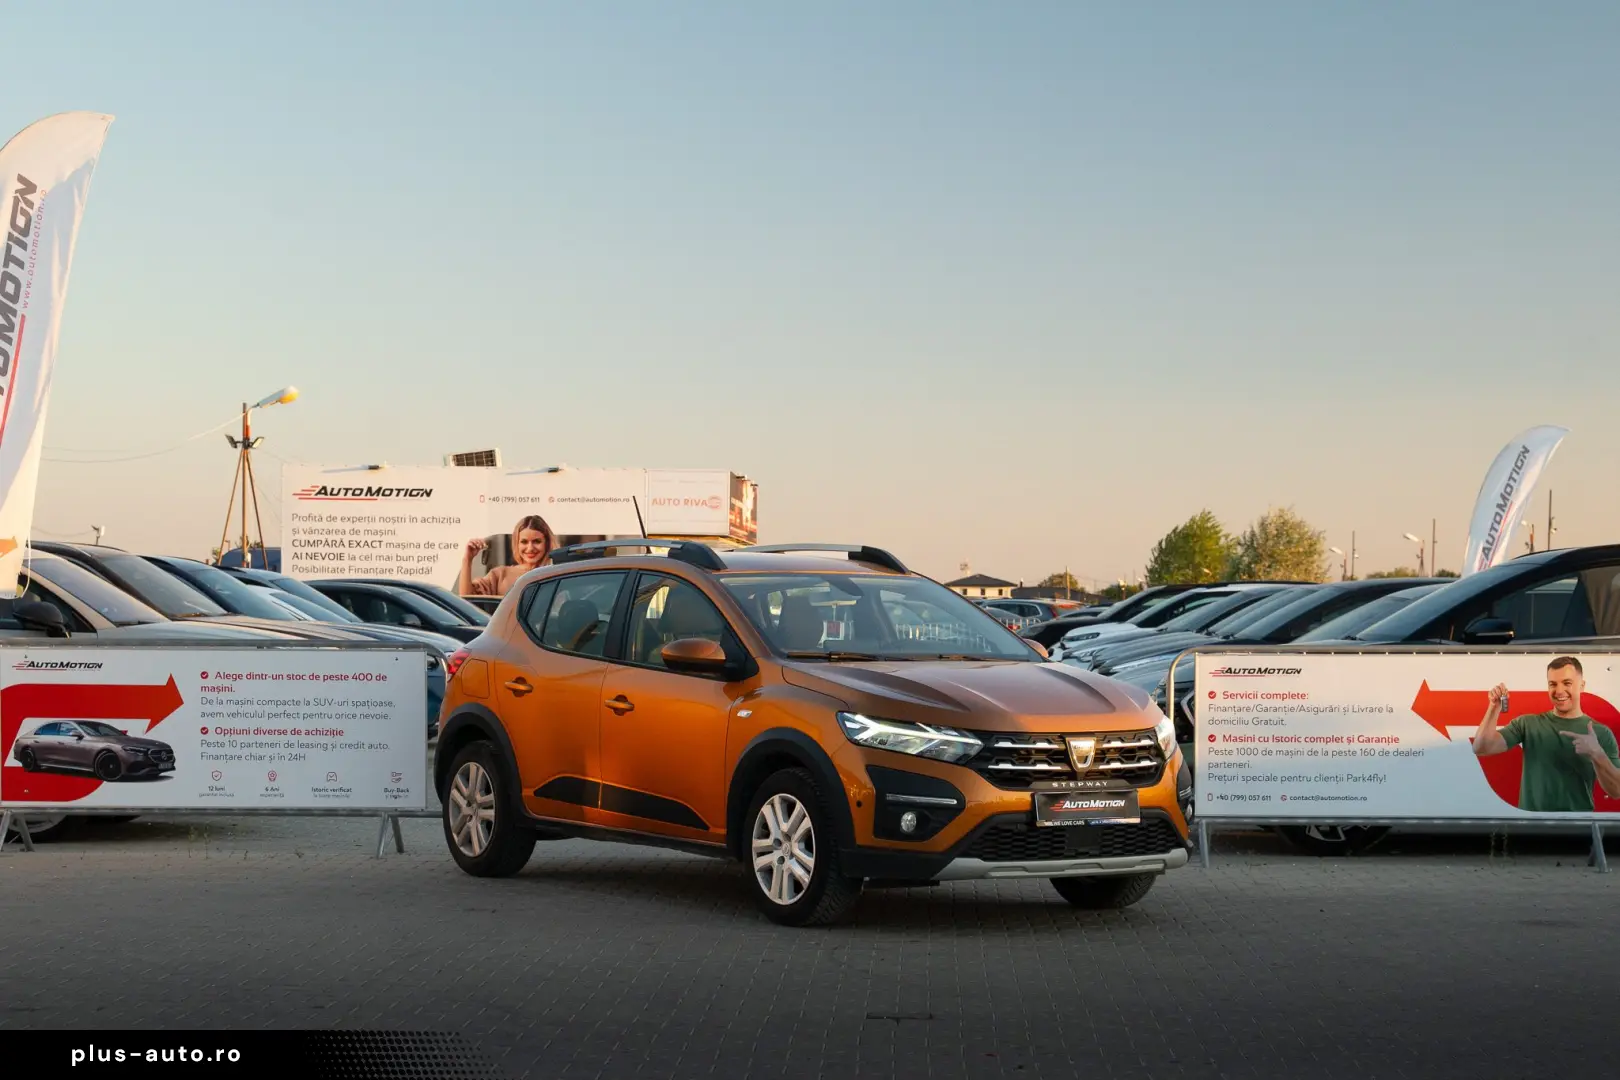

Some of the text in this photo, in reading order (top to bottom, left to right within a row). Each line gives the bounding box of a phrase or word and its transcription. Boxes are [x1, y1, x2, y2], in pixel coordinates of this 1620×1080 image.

[652, 498, 680, 506] AUTO
[326, 514, 338, 523] de
[379, 515, 405, 525] noștri
[409, 515, 418, 523] în
[302, 526, 346, 536] vânzarea
[349, 527, 361, 536] de
[292, 538, 458, 551] CUMPĂRĂ EXACT mașina de care
[306, 552, 344, 561] NEVOIE
[348, 553, 356, 561] la
[359, 553, 372, 561] cel
[375, 553, 393, 561] mai
[396, 554, 414, 562] bun
[292, 565, 345, 574] Posibilitate
[349, 565, 394, 576] Finanțare
[215, 672, 387, 684] Alege dintr-un stoc de peste 400 de
[201, 684, 235, 695] mașini.
[1222, 691, 1309, 702] Servicii complete:
[201, 697, 214, 705] De
[216, 698, 224, 706] la
[226, 698, 254, 708] mașini
[257, 698, 301, 709] compacte
[303, 699, 311, 707] la
[313, 698, 349, 707] SUV-uri
[201, 711, 224, 719] avem
[226, 710, 265, 719] vehiculul
[267, 711, 300, 722] perfect
[303, 713, 333, 722] pentru
[335, 712, 357, 720] orice
[1343, 705, 1349, 716] și
[1352, 705, 1383, 713] Livrare
[1386, 705, 1394, 713] la
[1208, 717, 1287, 726] domiciliu Gratuit.
[215, 727, 344, 738] Opțiuni diverse de achiziție
[201, 740, 225, 749] Peste
[240, 741, 281, 751] parteneri
[283, 741, 295, 749] de
[297, 741, 328, 752] leasing
[330, 742, 337, 752] și
[339, 741, 366, 750] credit
[1272, 735, 1301, 743] Istoric
[1304, 735, 1344, 746] complet
[1347, 735, 1355, 746] și
[1358, 736, 1399, 746] Garanție
[201, 753, 305, 764] Finanțare chiar și în 24H
[1208, 748, 1424, 759] Peste 1000 de mașini de la peste 160 de dealeri
[1208, 761, 1252, 770] parteneri.
[1208, 774, 1386, 785] Prețuri speciale pentru clienții Park4fly!
[1230, 794, 1247, 802] (799)
